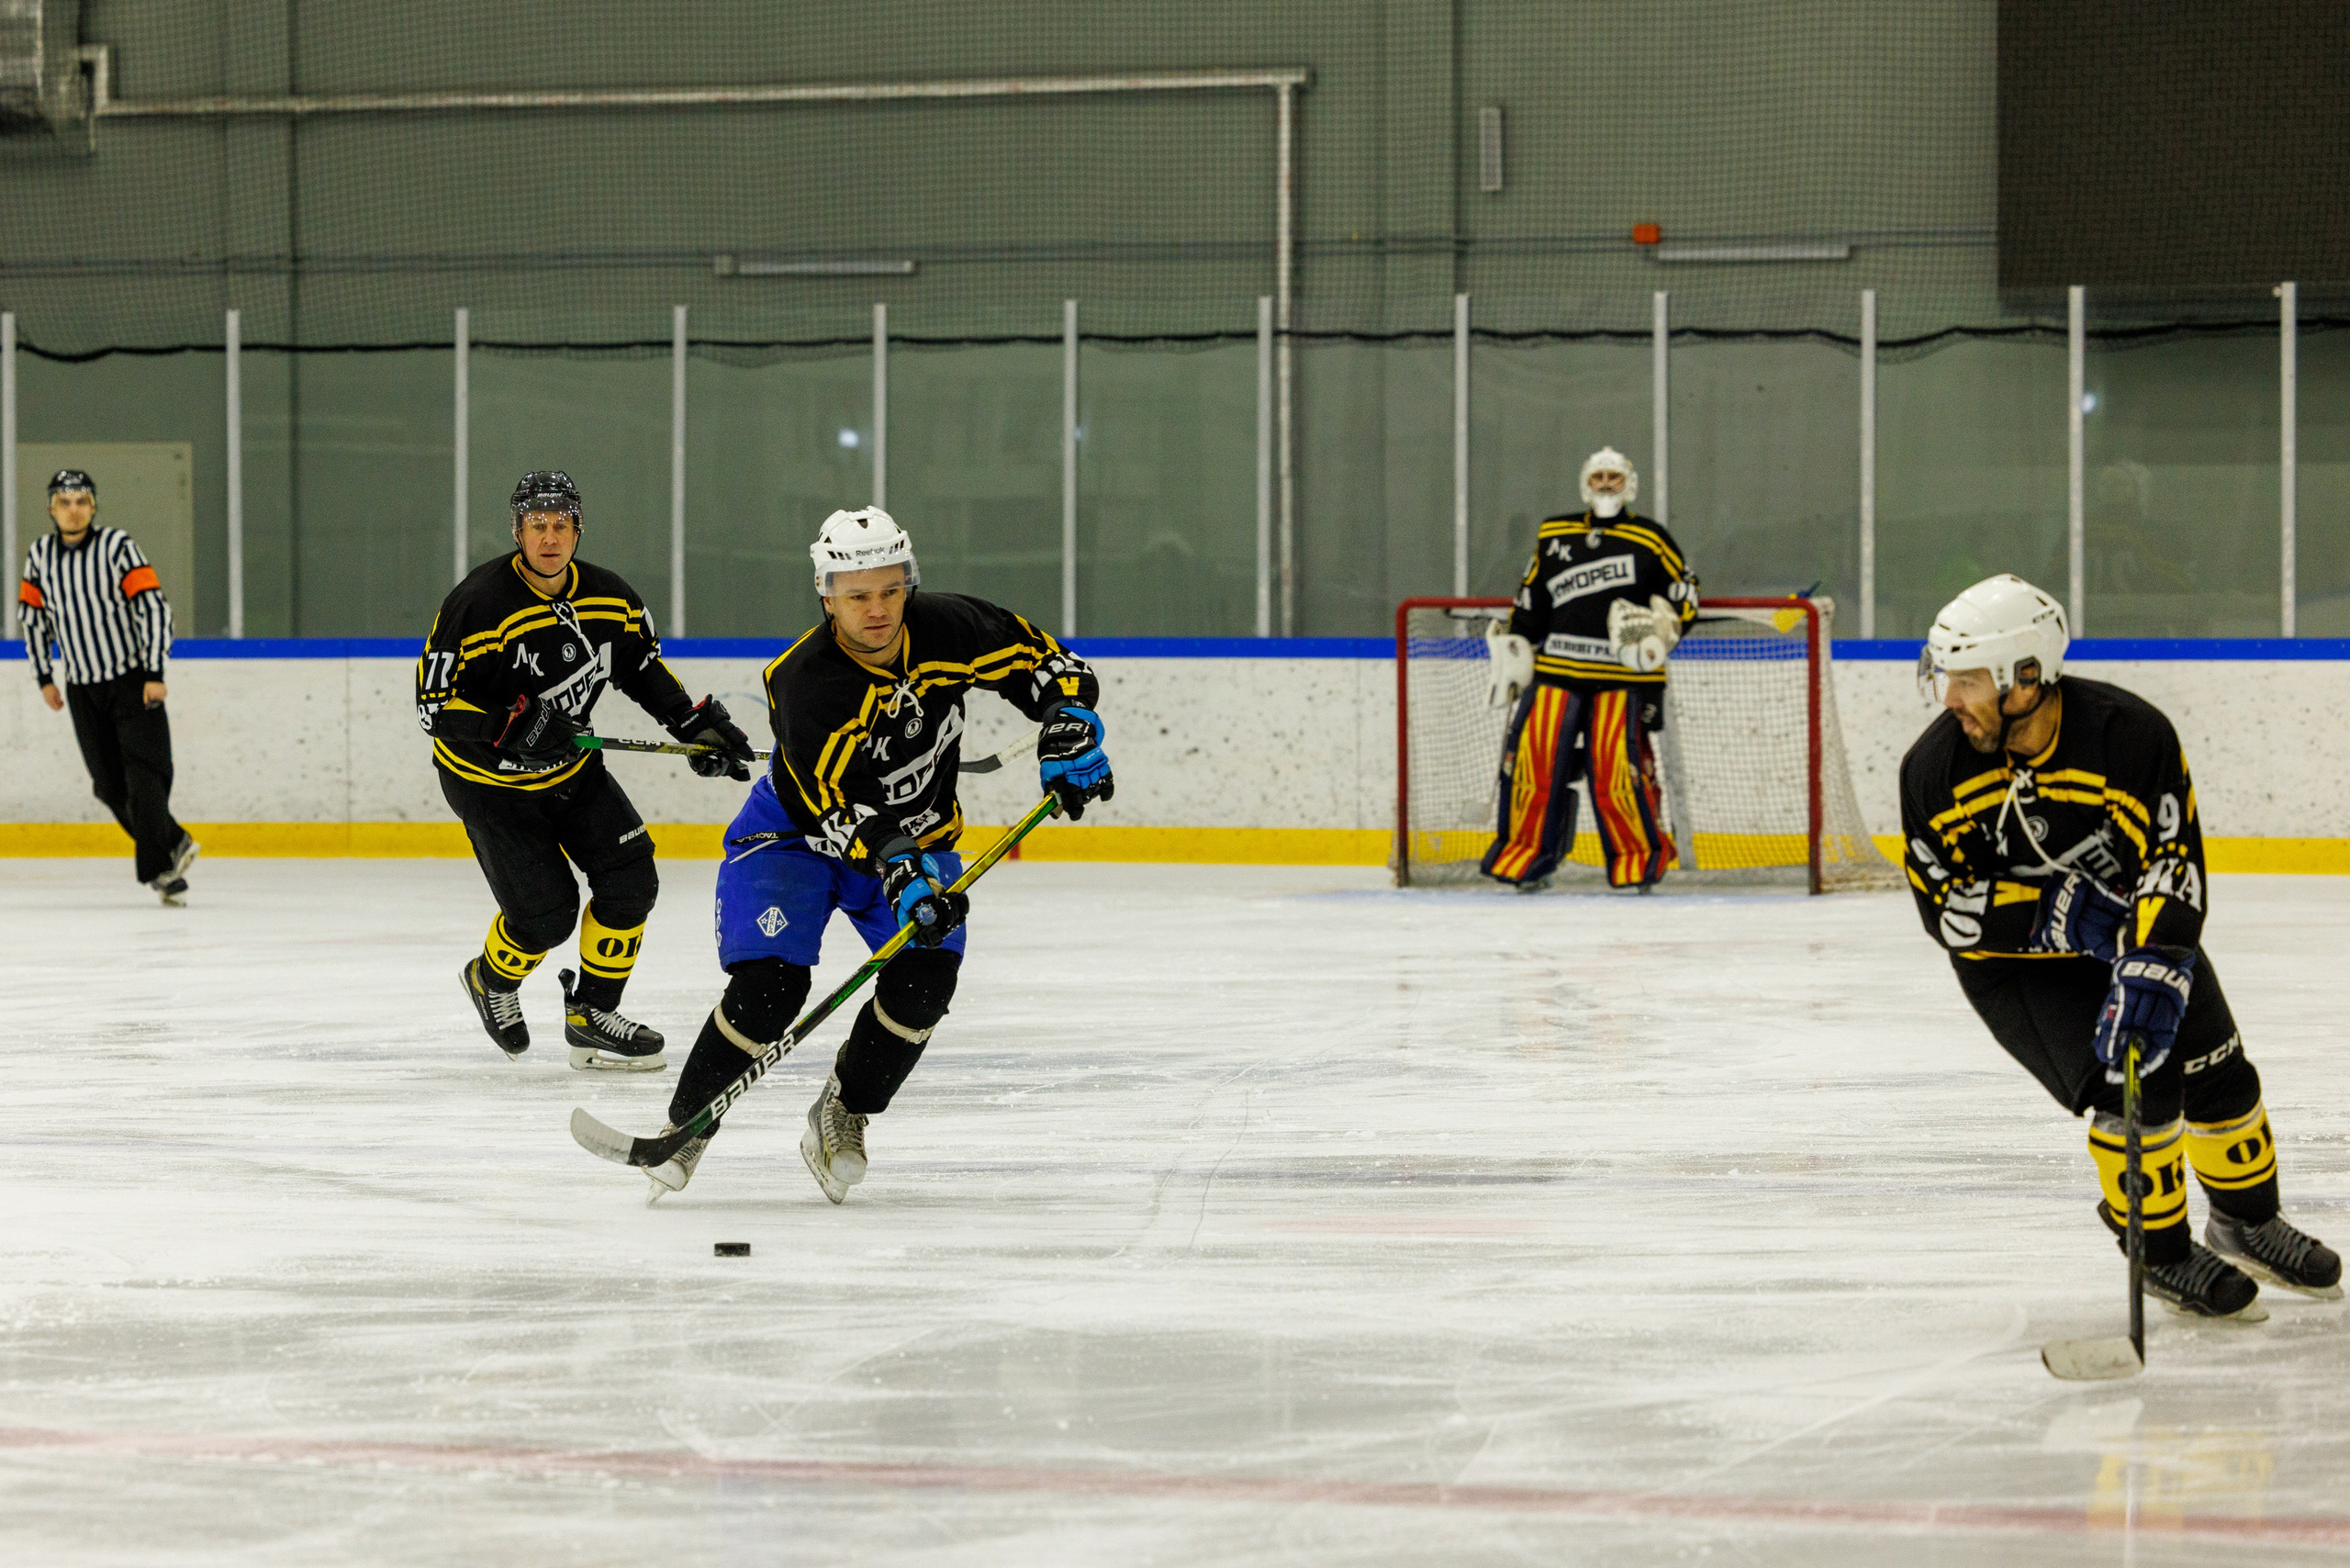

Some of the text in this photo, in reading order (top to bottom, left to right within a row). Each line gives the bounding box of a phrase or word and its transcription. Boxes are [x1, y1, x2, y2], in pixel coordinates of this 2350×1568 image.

[856, 547, 887, 557] Reebok
[424, 651, 455, 690] 77
[618, 738, 661, 747] CCM
[2157, 792, 2181, 843] 9
[736, 832, 779, 843] TACKLA
[710, 1033, 795, 1121] BAUER
